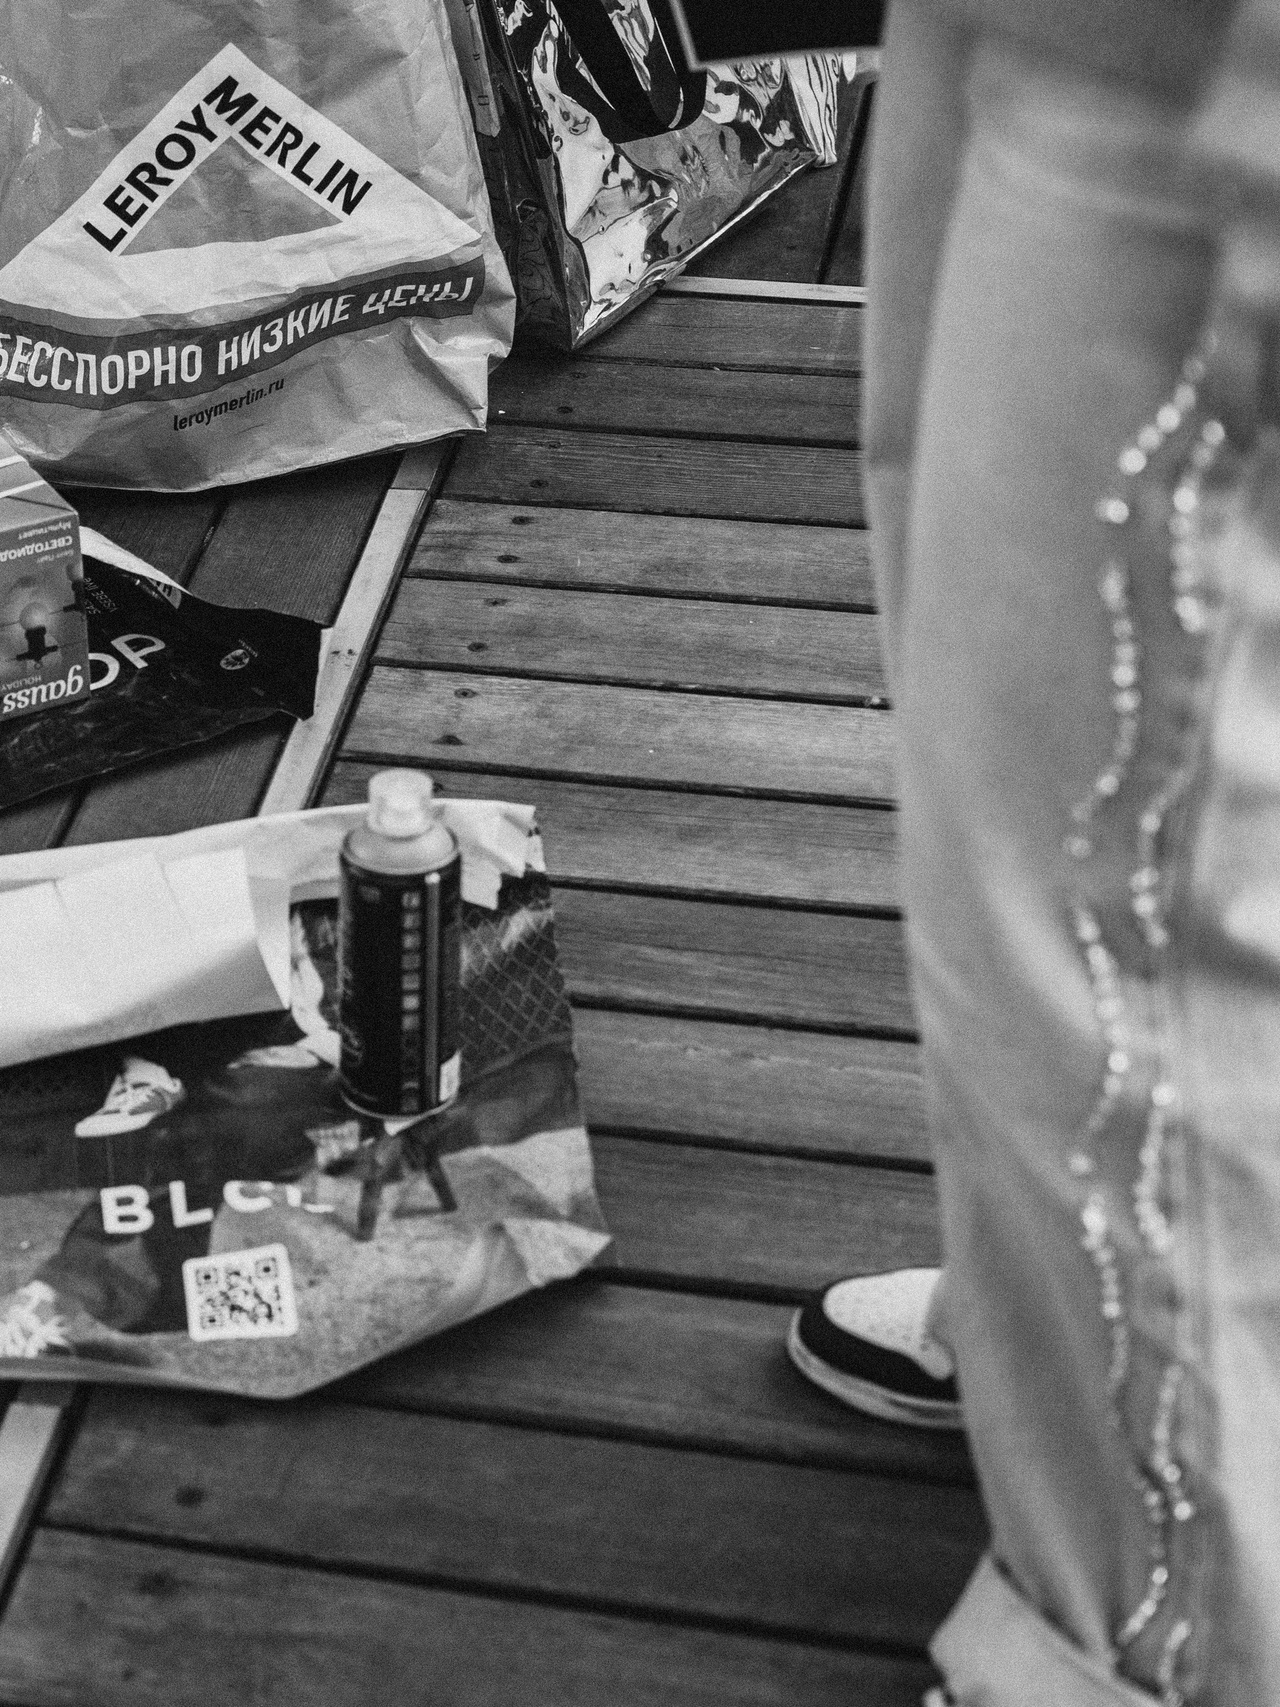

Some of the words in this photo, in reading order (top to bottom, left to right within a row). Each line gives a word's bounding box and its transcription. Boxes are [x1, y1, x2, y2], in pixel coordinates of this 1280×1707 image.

[83, 106, 218, 252] LEROY
[203, 76, 373, 215] MERLIN
[217, 294, 351, 376] НИЗКИЕ
[362, 276, 475, 315] ЦЕНЫ
[173, 378, 286, 431] leroymerlin.ru
[1, 674, 42, 692] HOLIDAY
[2, 664, 84, 714] gauss
